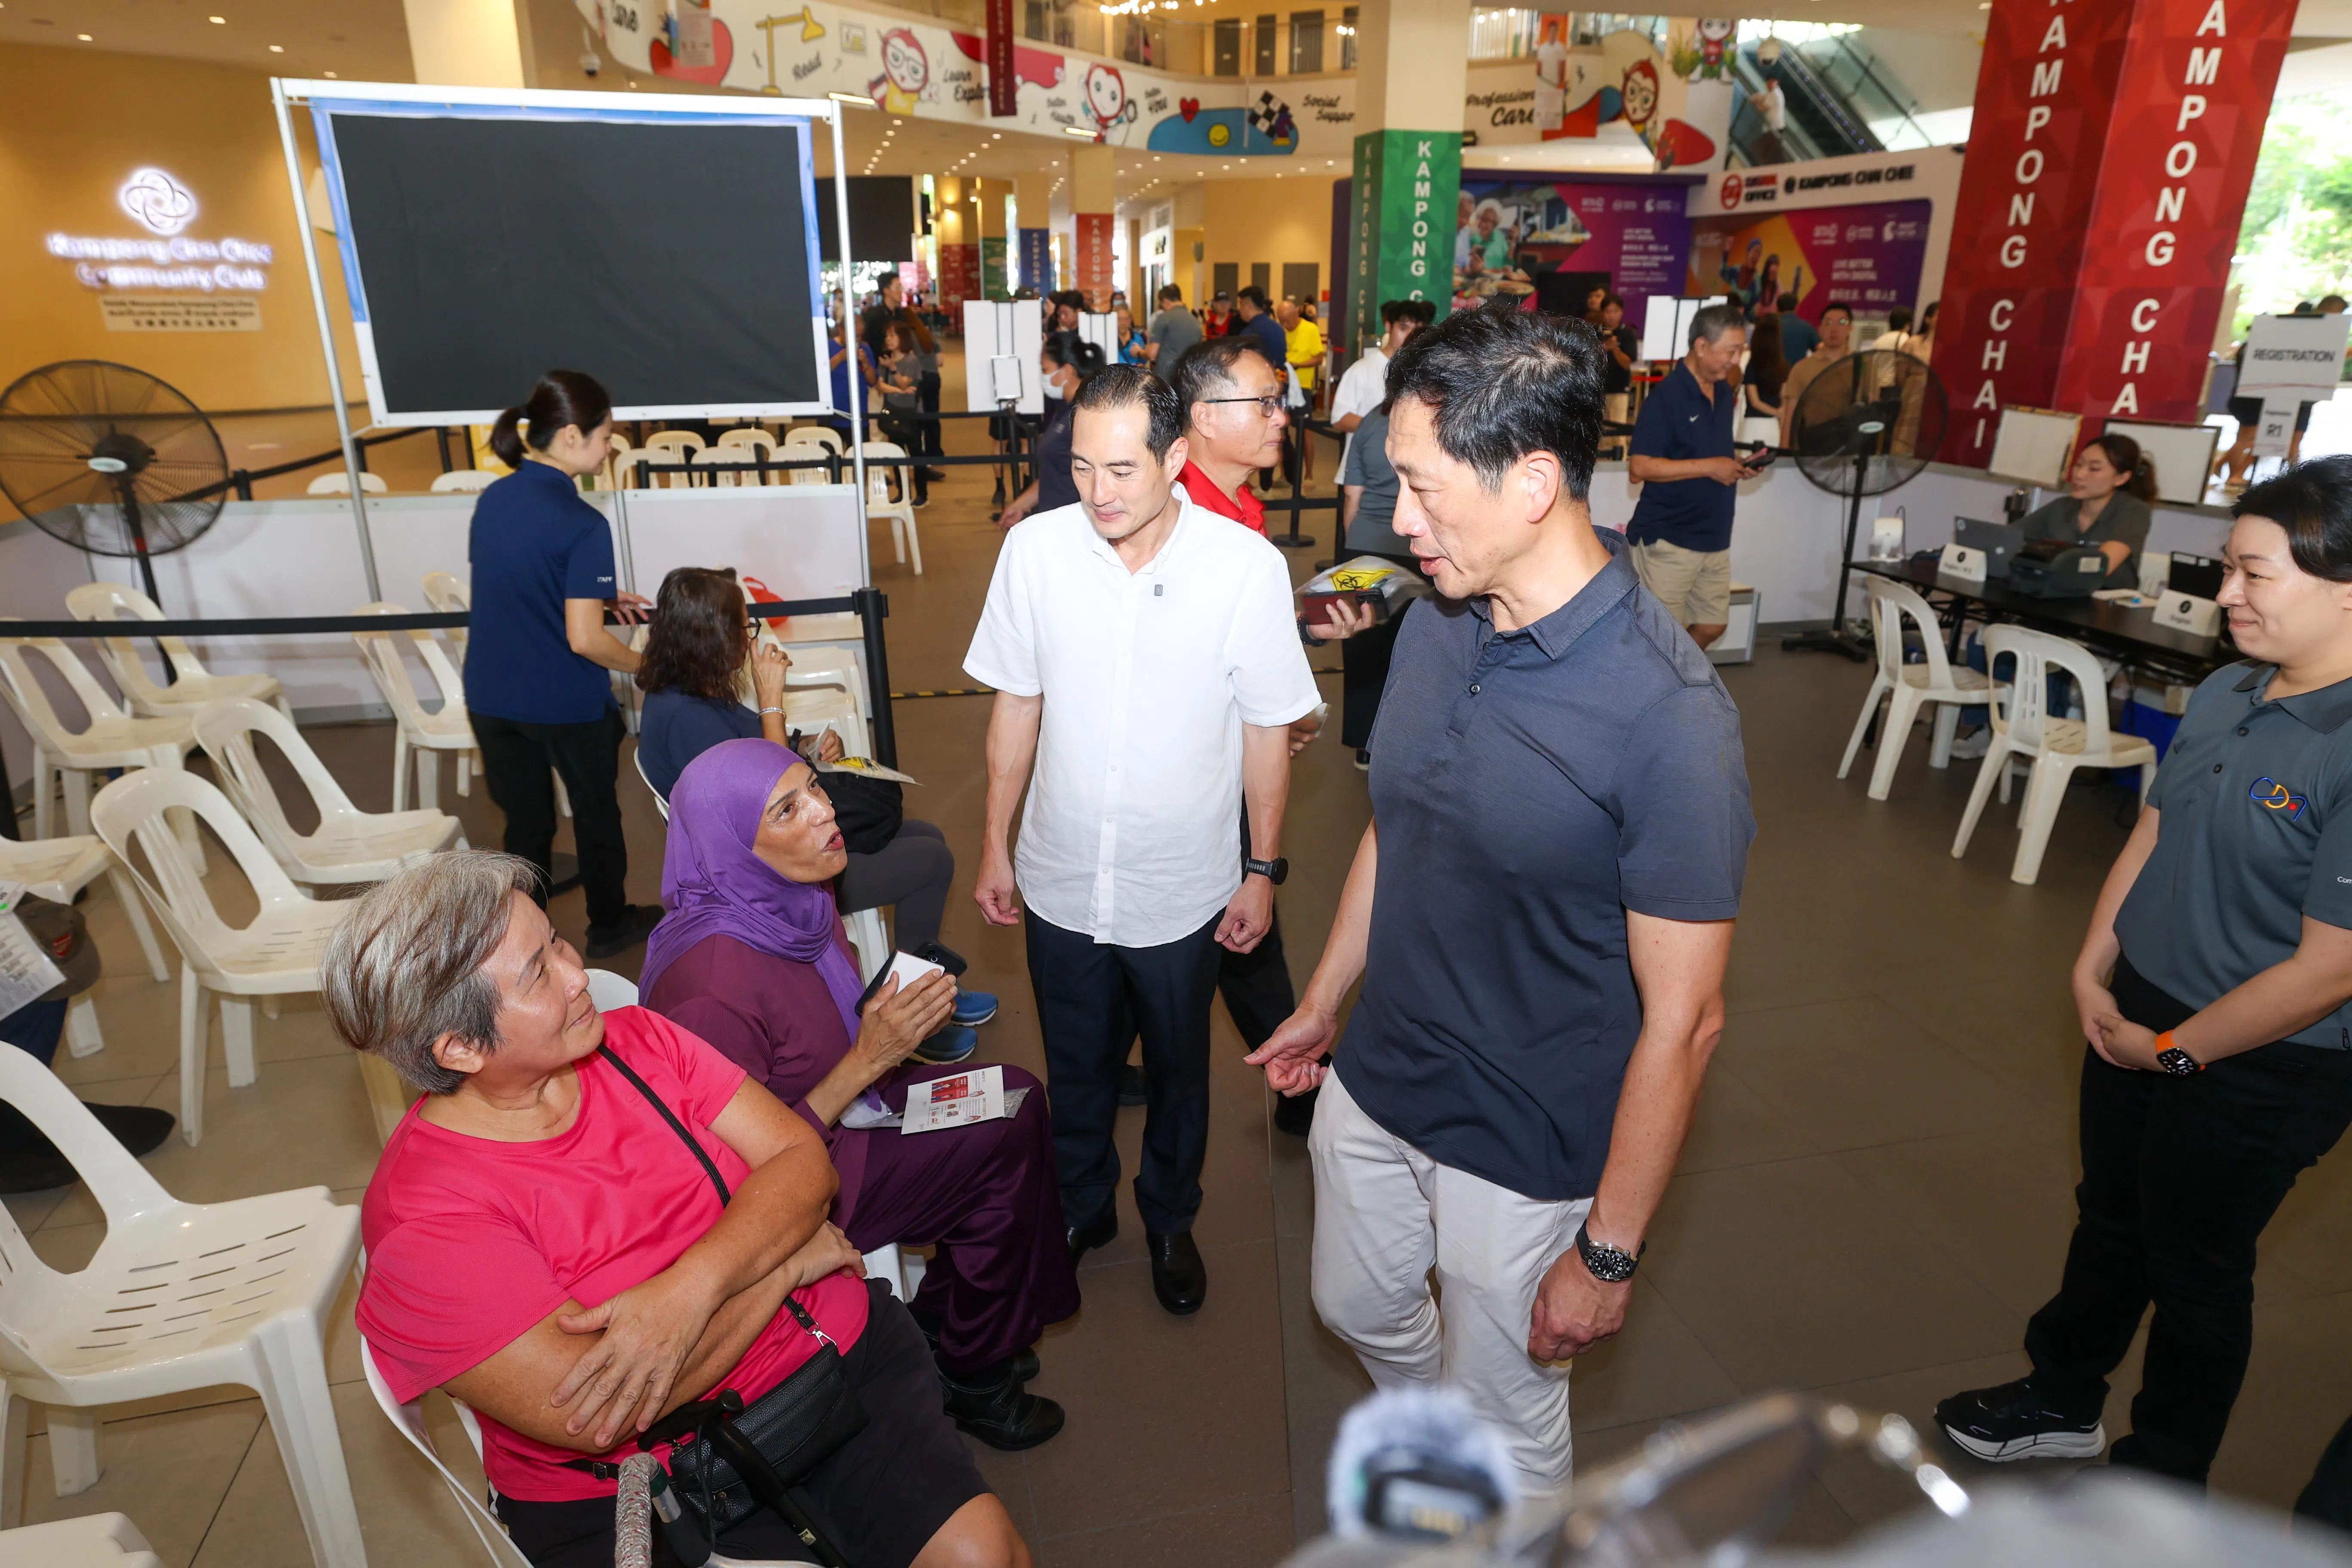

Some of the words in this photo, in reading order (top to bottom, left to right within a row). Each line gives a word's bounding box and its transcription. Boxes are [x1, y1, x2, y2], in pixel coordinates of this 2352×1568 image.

[792, 50, 822, 81] Read
[943, 69, 972, 82] Learn
[954, 82, 991, 105] Explo
[1302, 94, 1341, 107] Social
[1465, 89, 1535, 108] Profession
[1315, 108, 1355, 123] Suppor
[2000, 0, 2074, 268] AMPONG
[2145, 0, 2227, 266] AMPONG
[1798, 172, 1851, 190] KAMPONG
[1410, 140, 1432, 277] KAMPONG
[1745, 189, 1776, 202] OFFICE
[1360, 144, 1372, 276] KAMPONG
[48, 233, 170, 263] Kampong
[1091, 217, 1101, 282] KAMPONG
[77, 263, 213, 291] Community
[214, 265, 264, 289] Club
[2111, 298, 2159, 414] CHA
[2253, 348, 2336, 362] REGISTRATION
[1973, 299, 2015, 448] CHAI
[2337, 876, 2352, 884] Com
